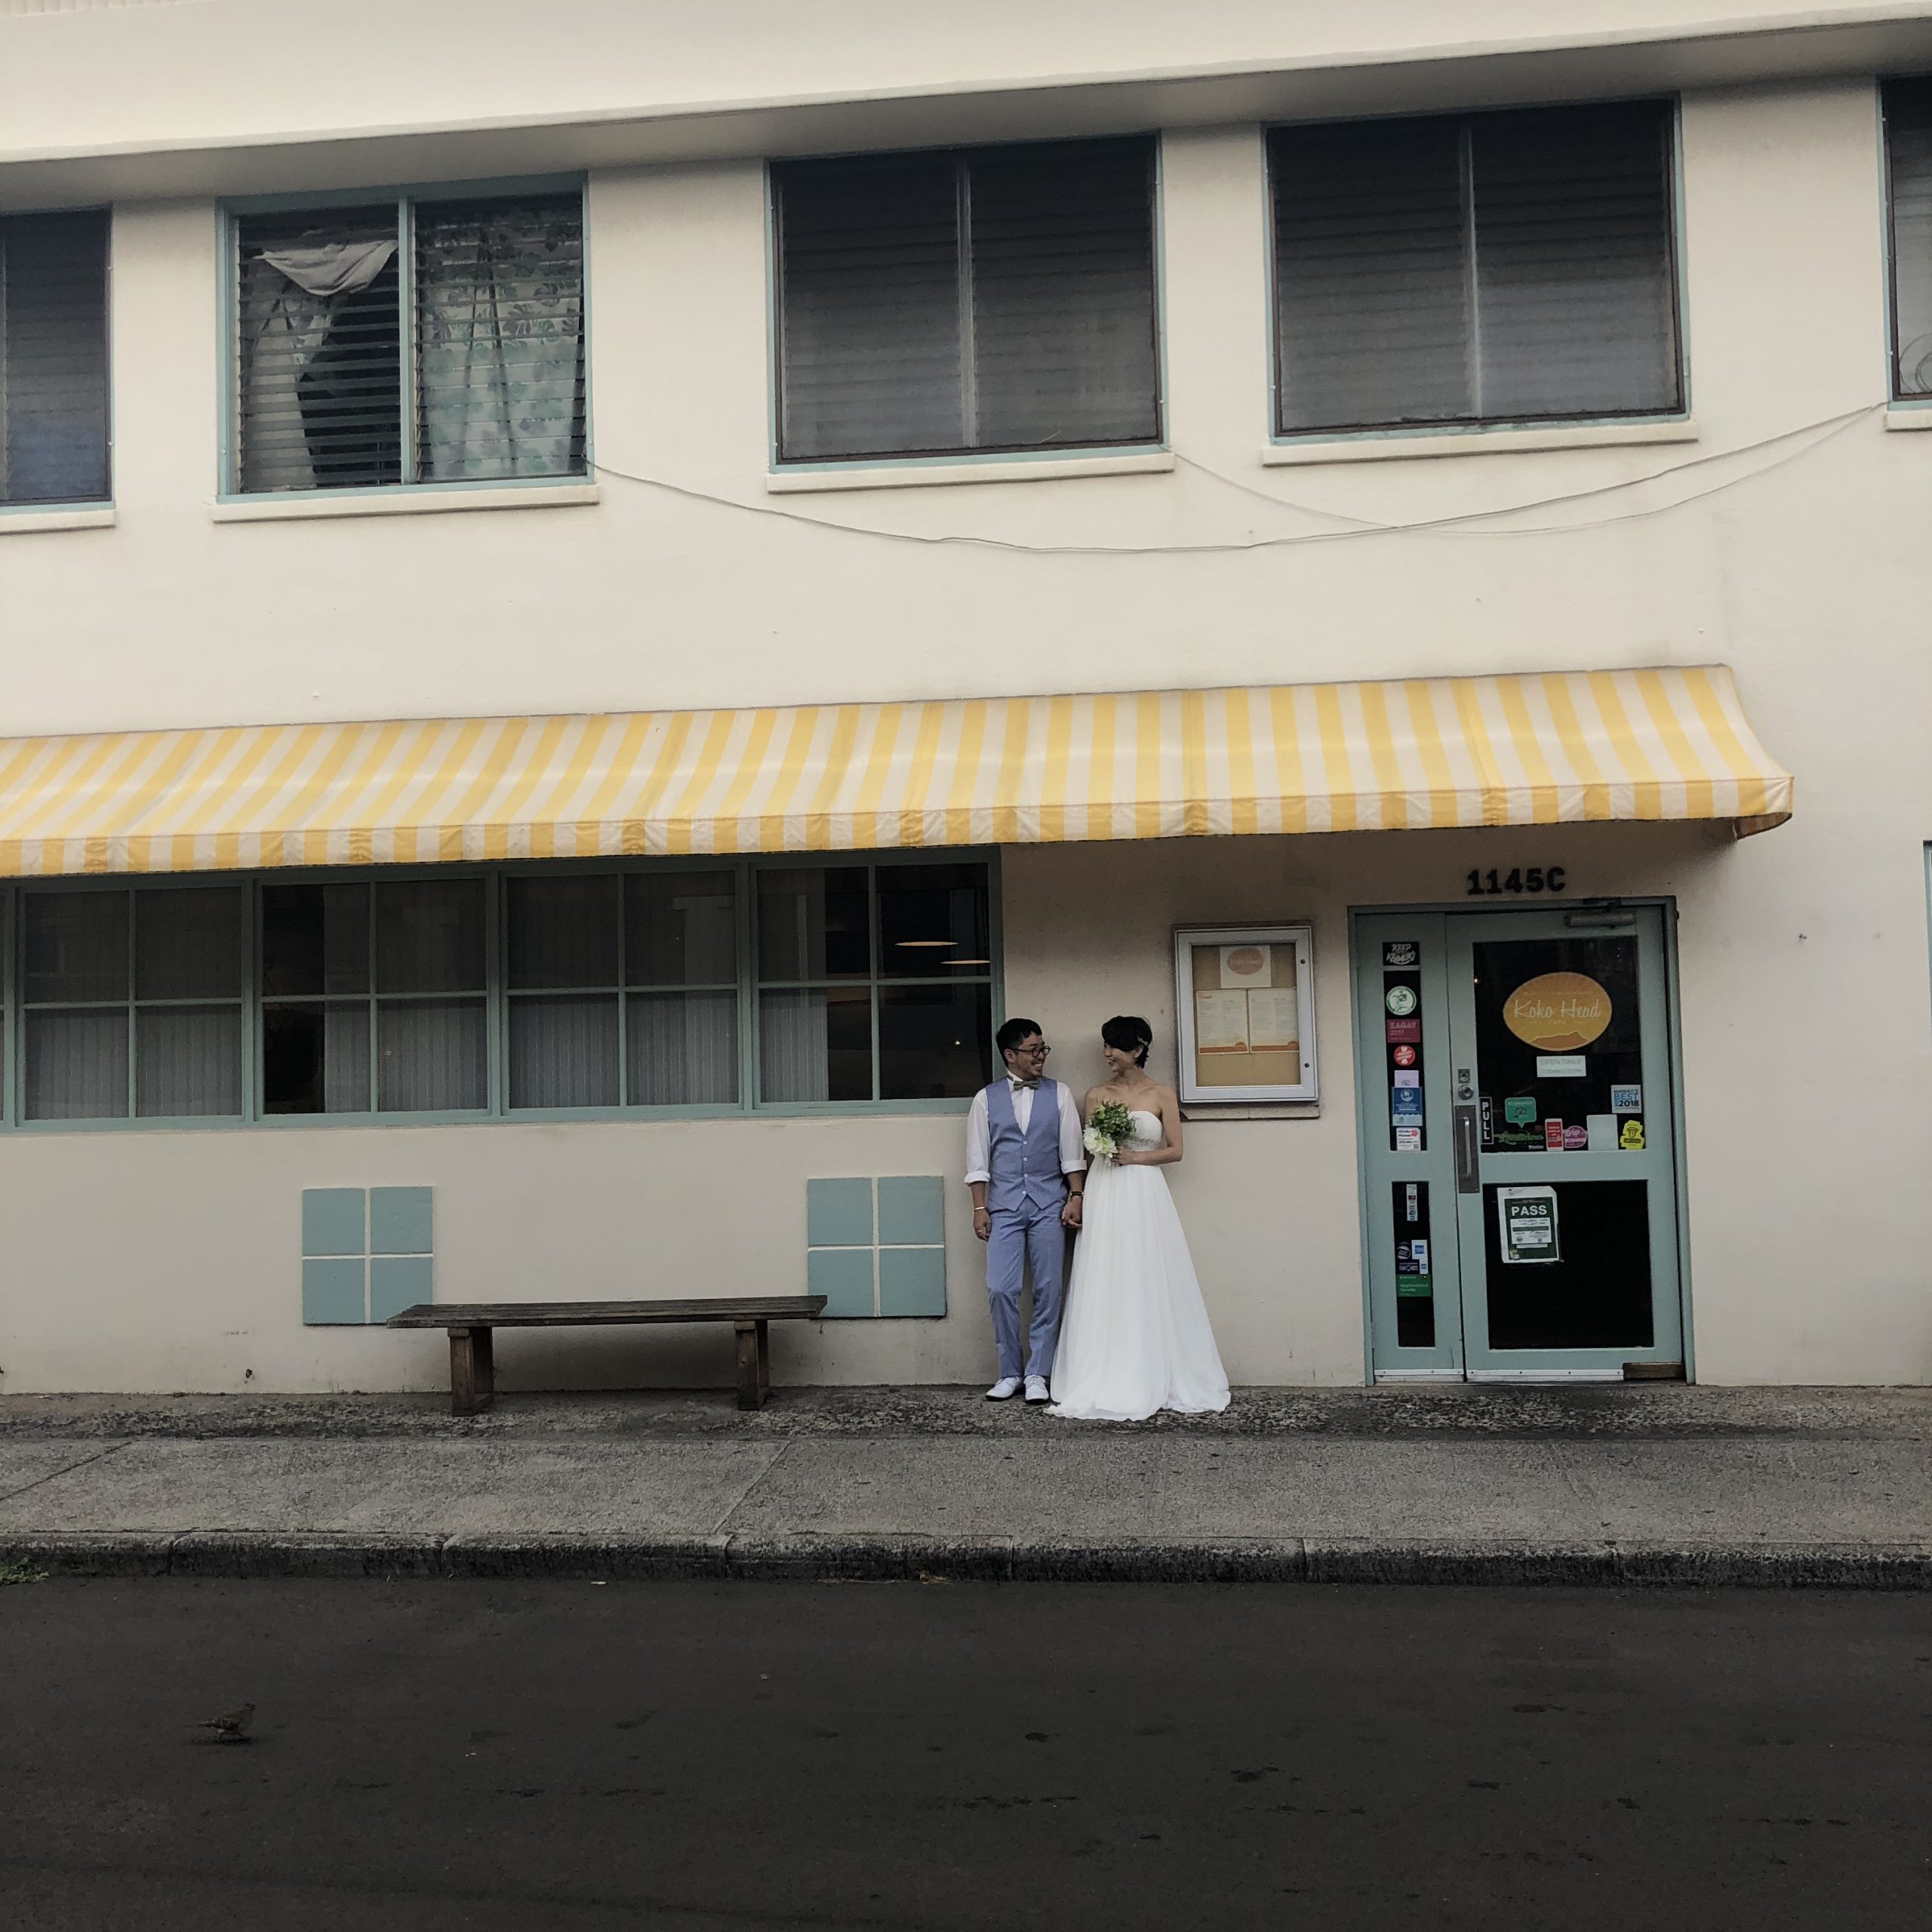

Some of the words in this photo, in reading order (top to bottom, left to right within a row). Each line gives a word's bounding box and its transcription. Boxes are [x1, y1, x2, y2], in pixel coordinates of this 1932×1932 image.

[1468, 866, 1566, 894] 1145C
[1514, 998, 1555, 1018] Koko
[1560, 998, 1601, 1018] Head
[1481, 1102, 1491, 1140] PULL
[1511, 1204, 1547, 1217] PASS
